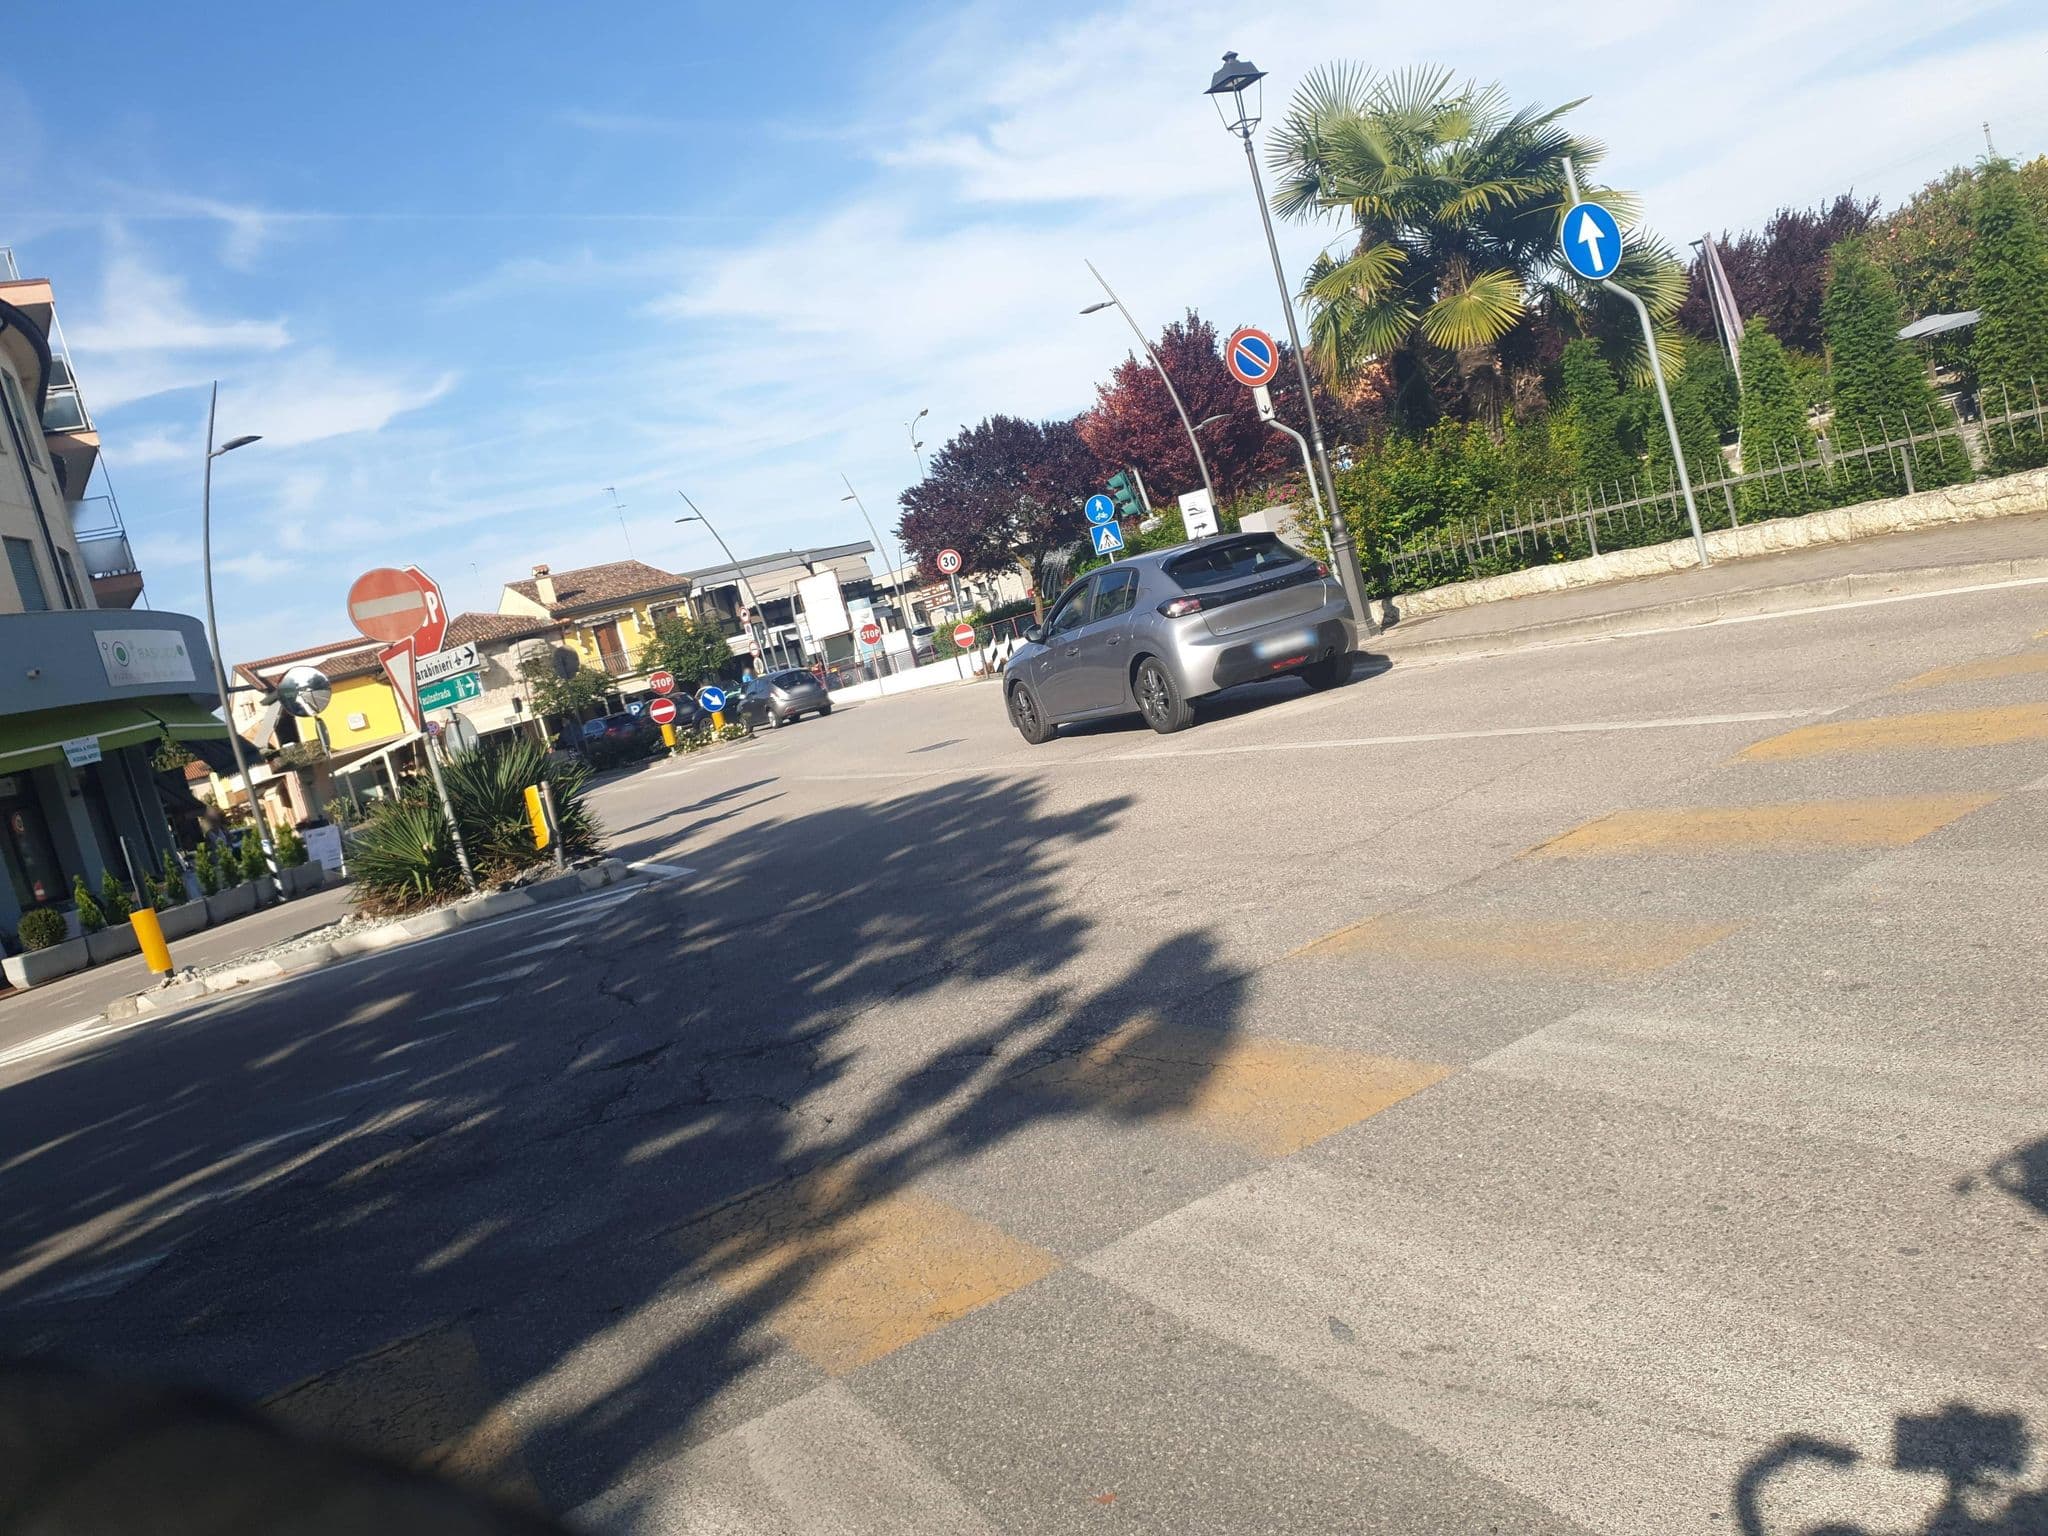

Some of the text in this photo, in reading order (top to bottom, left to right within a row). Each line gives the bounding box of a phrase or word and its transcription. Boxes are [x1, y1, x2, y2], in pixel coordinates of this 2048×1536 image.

[943, 555, 957, 568] 30
[860, 628, 881, 640] STOP
[416, 657, 453, 681] arabinieri
[651, 676, 672, 688] STOP
